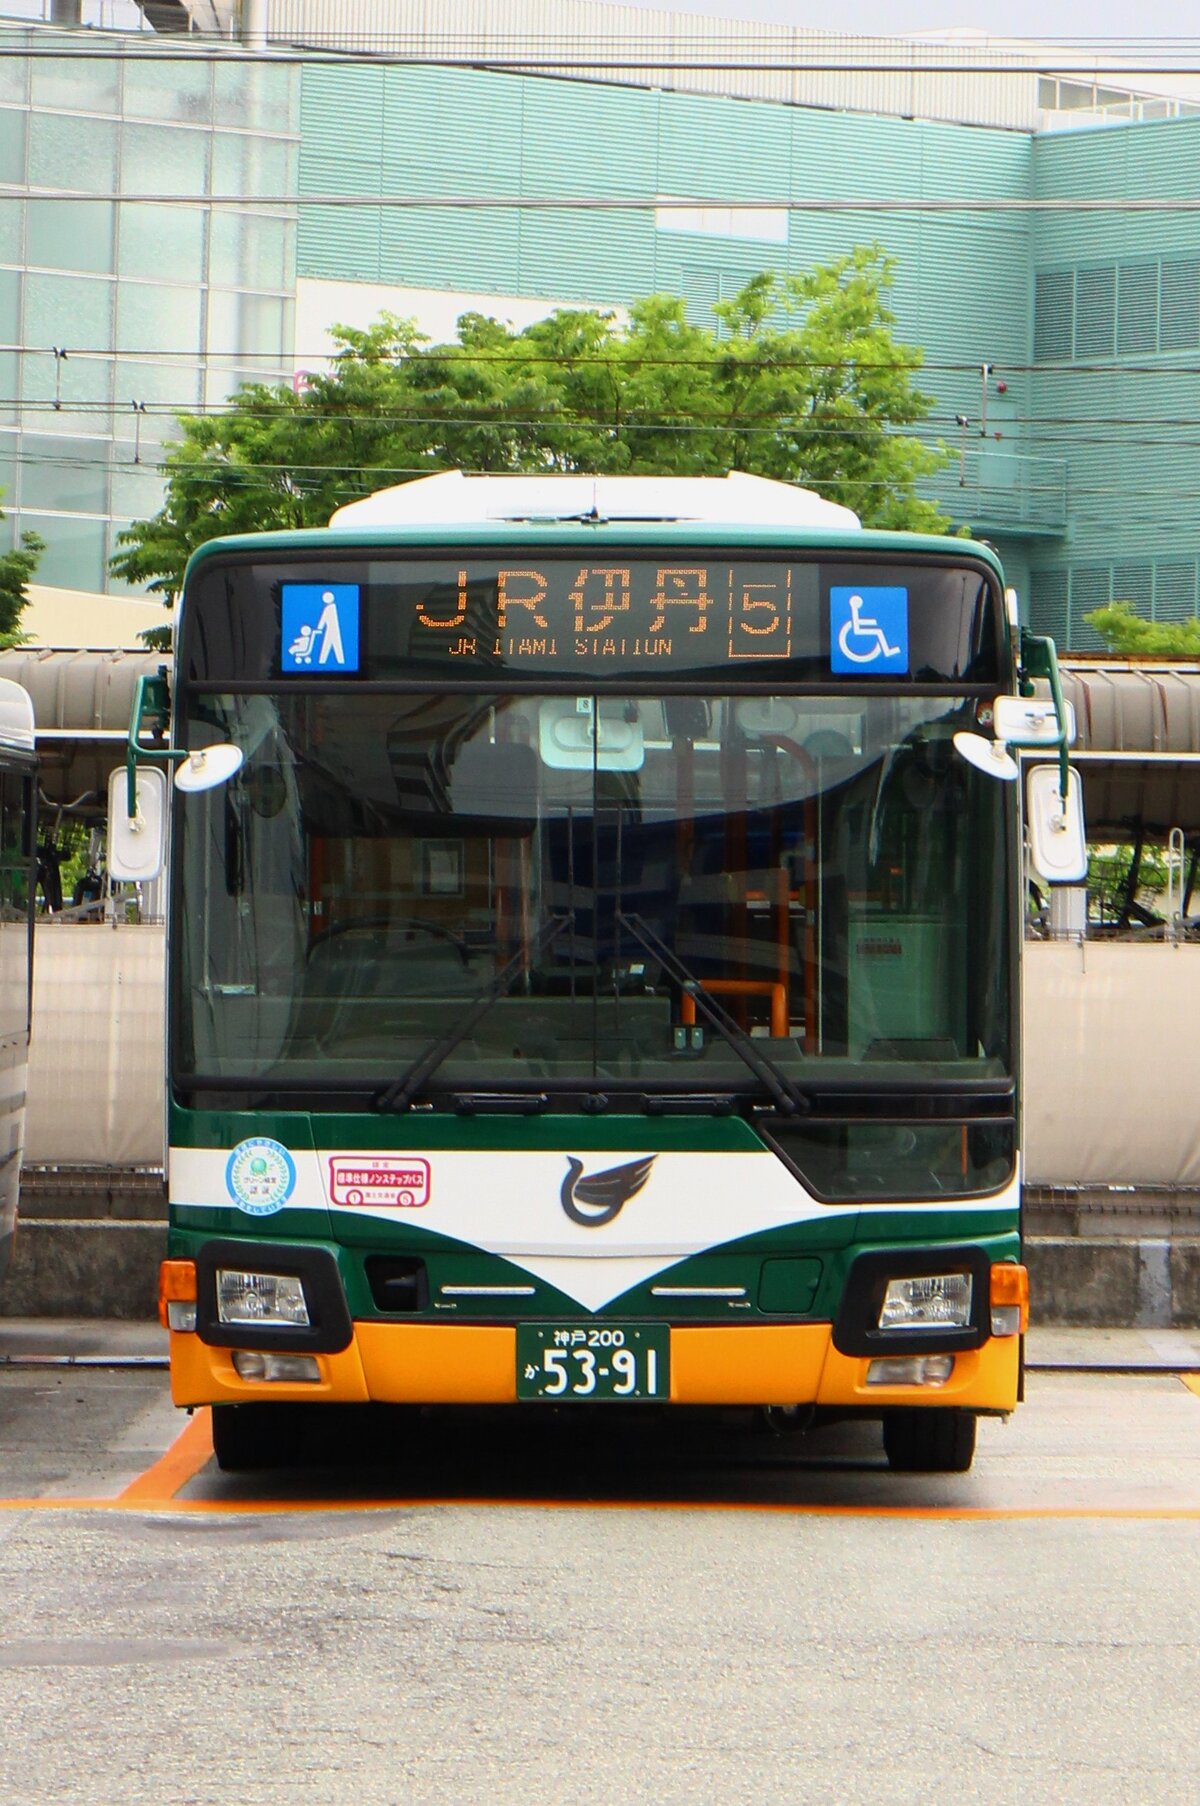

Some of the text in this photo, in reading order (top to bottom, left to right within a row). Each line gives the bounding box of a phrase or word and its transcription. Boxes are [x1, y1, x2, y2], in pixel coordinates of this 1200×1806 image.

[416, 569, 780, 635] JR伊丹 5
[553, 1329, 625, 1347] 神戸200
[524, 1348, 657, 1395] か 53-91
